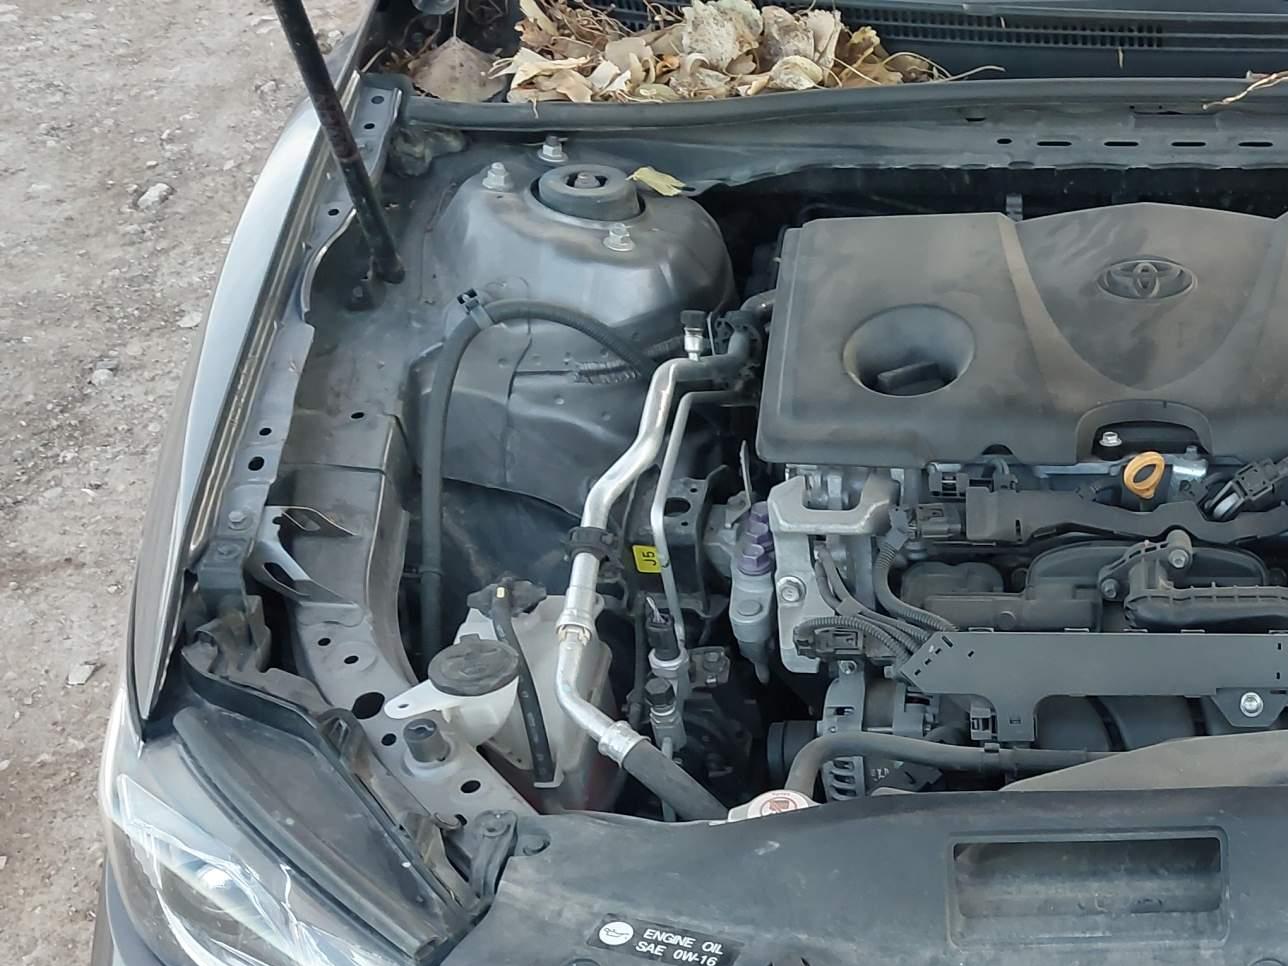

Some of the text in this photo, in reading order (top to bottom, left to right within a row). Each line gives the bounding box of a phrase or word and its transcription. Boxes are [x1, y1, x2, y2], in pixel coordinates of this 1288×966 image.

[643, 552, 656, 566] J5
[636, 941, 718, 966] SAE 0W-16
[643, 929, 723, 955] ENGINE OIL
